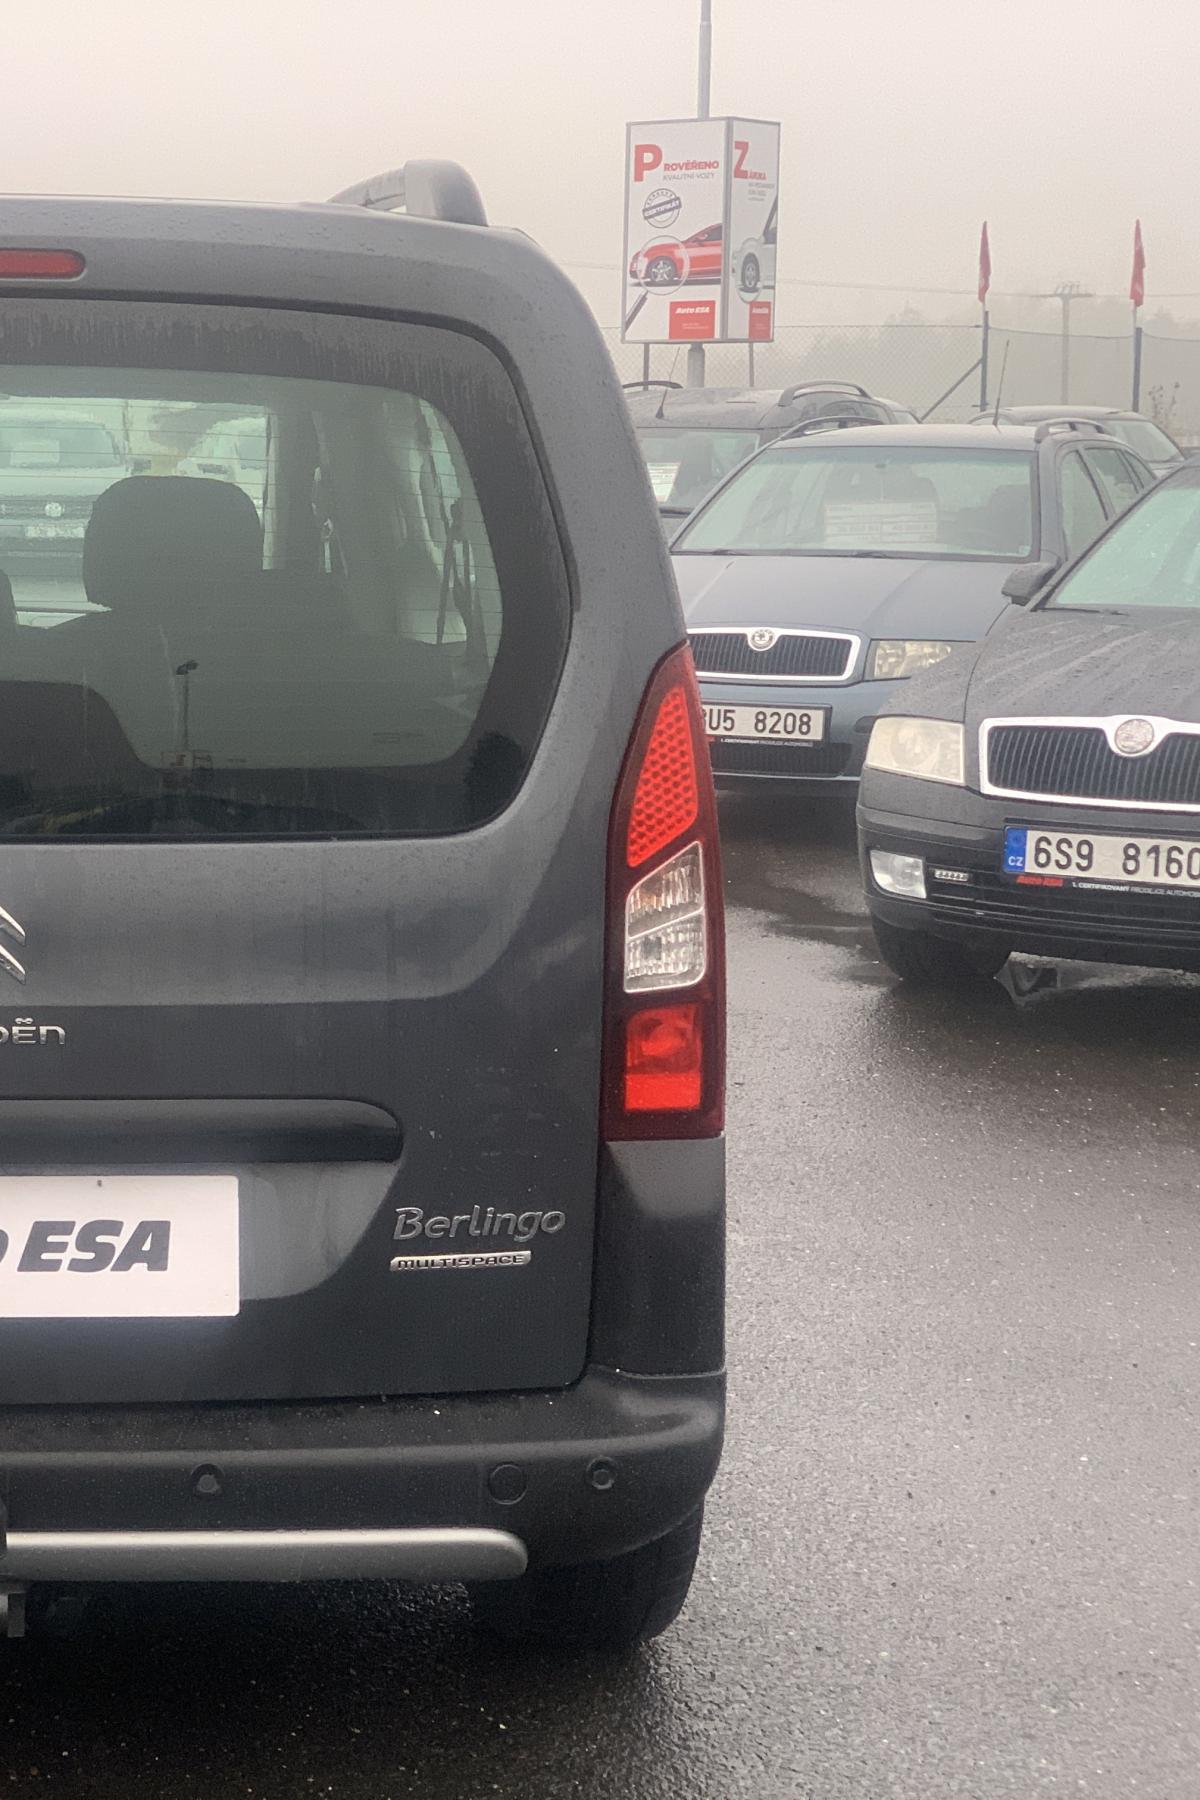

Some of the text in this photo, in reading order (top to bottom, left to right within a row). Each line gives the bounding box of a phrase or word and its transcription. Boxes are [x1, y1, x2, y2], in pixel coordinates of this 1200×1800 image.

[754, 711, 812, 735] 8208
[1008, 856, 1024, 867] CZ
[1034, 835, 1200, 880] 6S9 8160
[392, 1204, 566, 1243] Berlingo
[16, 1219, 172, 1273] ESA
[397, 1254, 525, 1270] MULTISPACE
